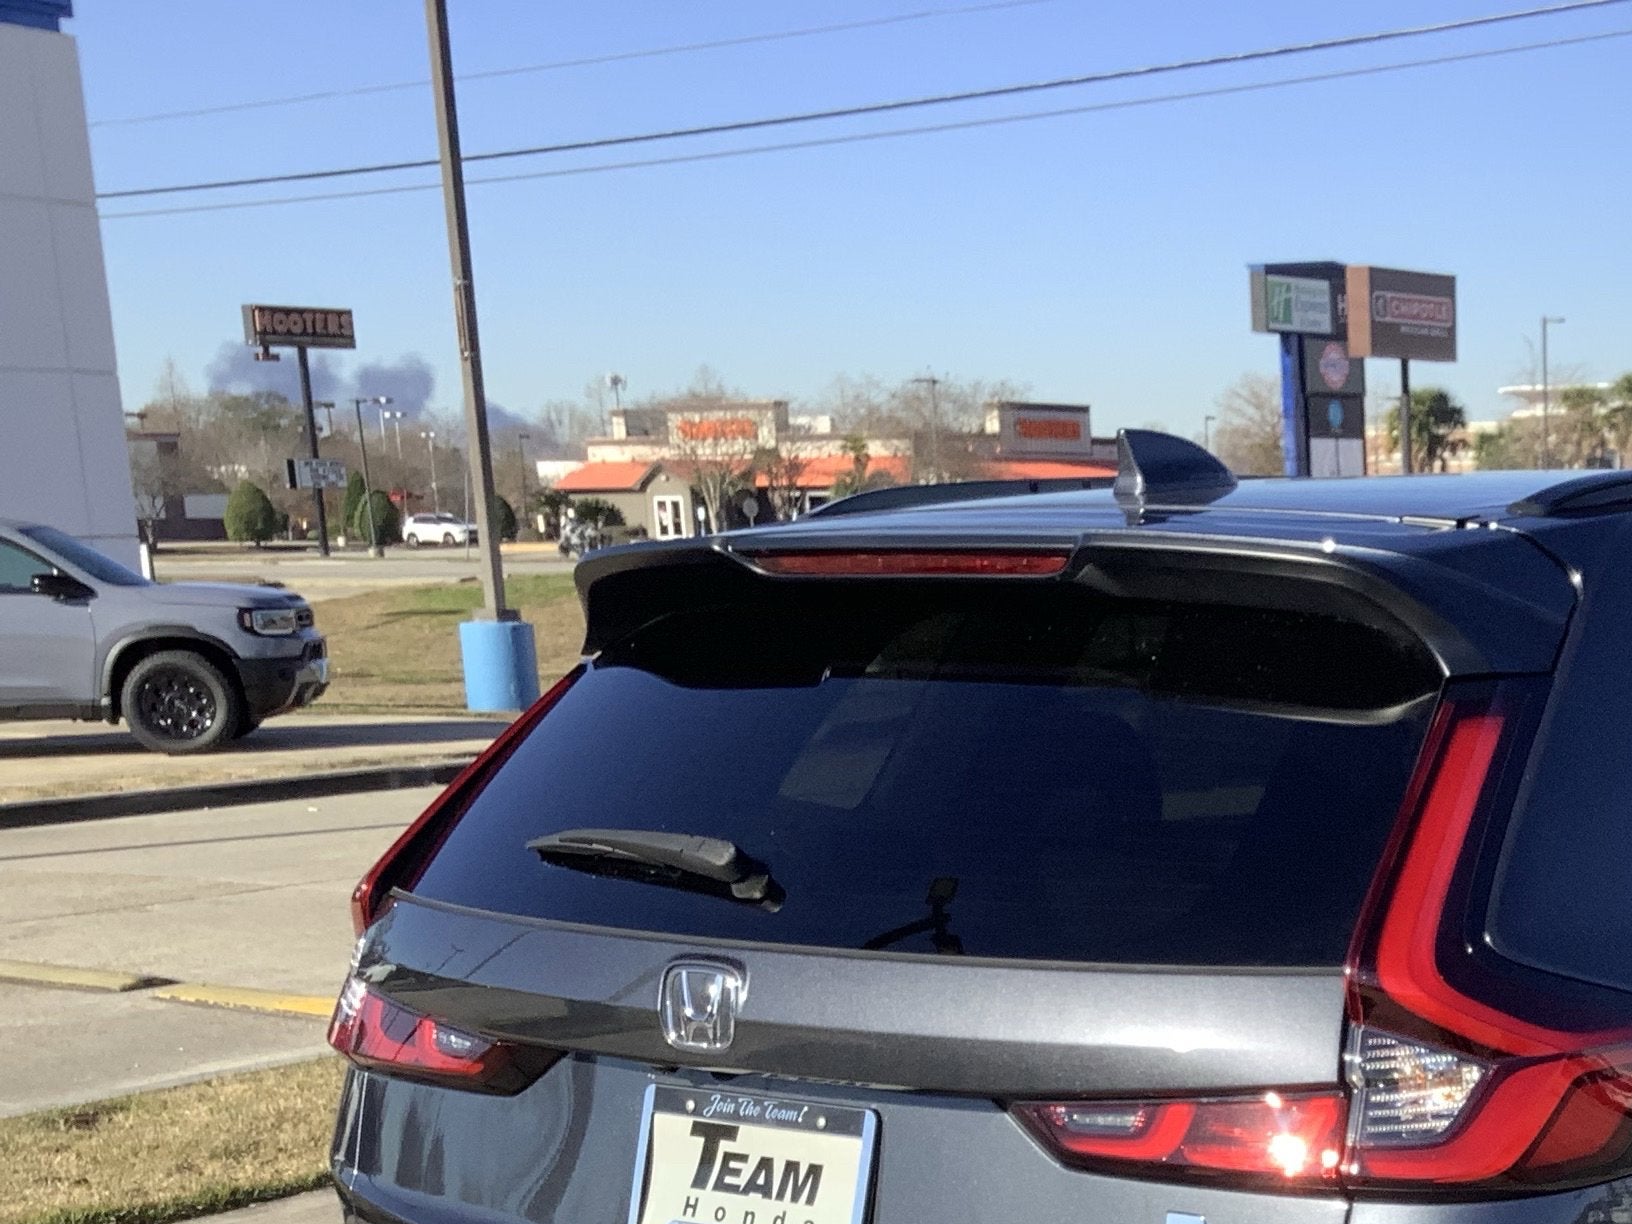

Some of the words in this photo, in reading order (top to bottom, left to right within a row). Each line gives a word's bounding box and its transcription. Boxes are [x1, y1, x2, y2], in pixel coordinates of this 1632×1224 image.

[255, 308, 353, 336] HOOTERS
[703, 1094, 735, 1117] Join
[738, 1097, 761, 1117] The
[763, 1101, 808, 1122] Team!
